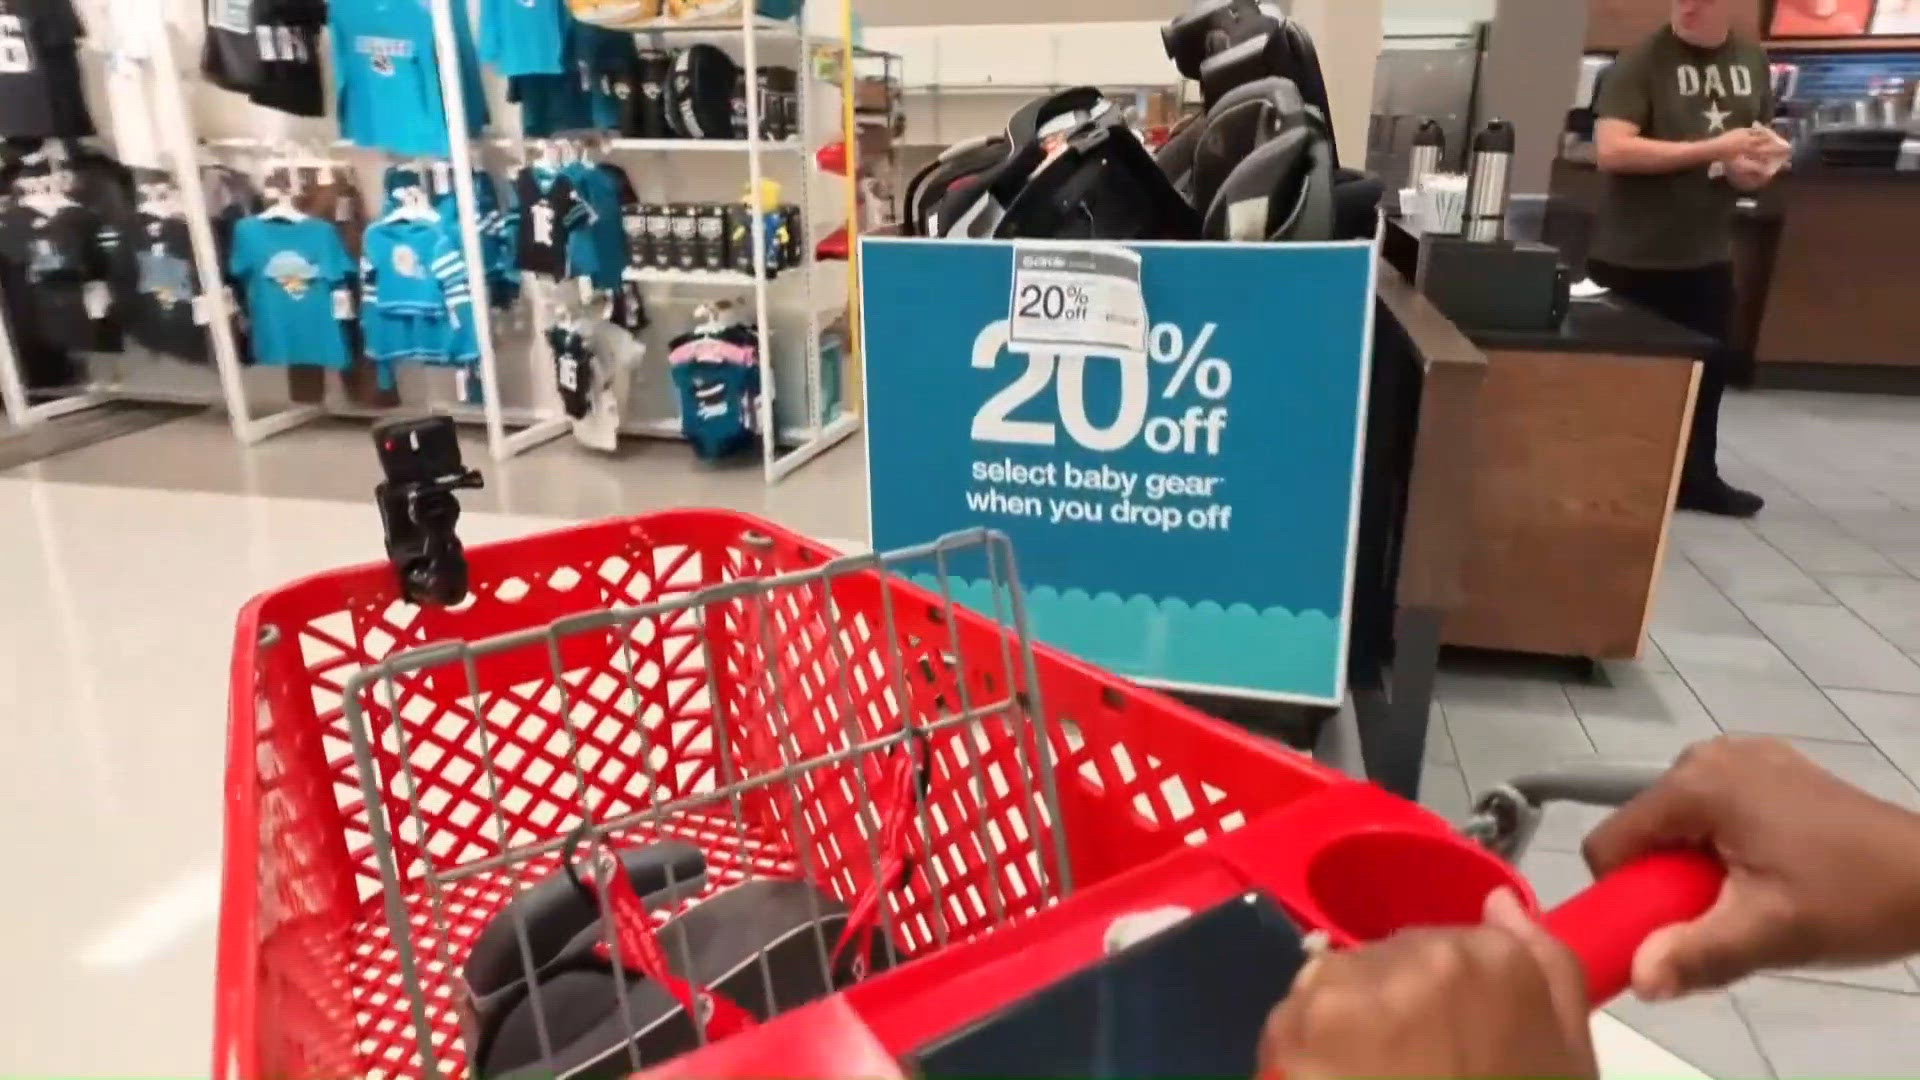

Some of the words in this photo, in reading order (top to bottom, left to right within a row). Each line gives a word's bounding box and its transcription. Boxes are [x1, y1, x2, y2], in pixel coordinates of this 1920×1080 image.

[1677, 64, 1752, 97] DAD
[1144, 406, 1228, 455] off
[972, 457, 1057, 487] select
[1064, 461, 1138, 497] baby
[966, 487, 1042, 517] when
[1050, 499, 1102, 524] you
[1110, 498, 1183, 531] drop
[1187, 504, 1232, 530] off
